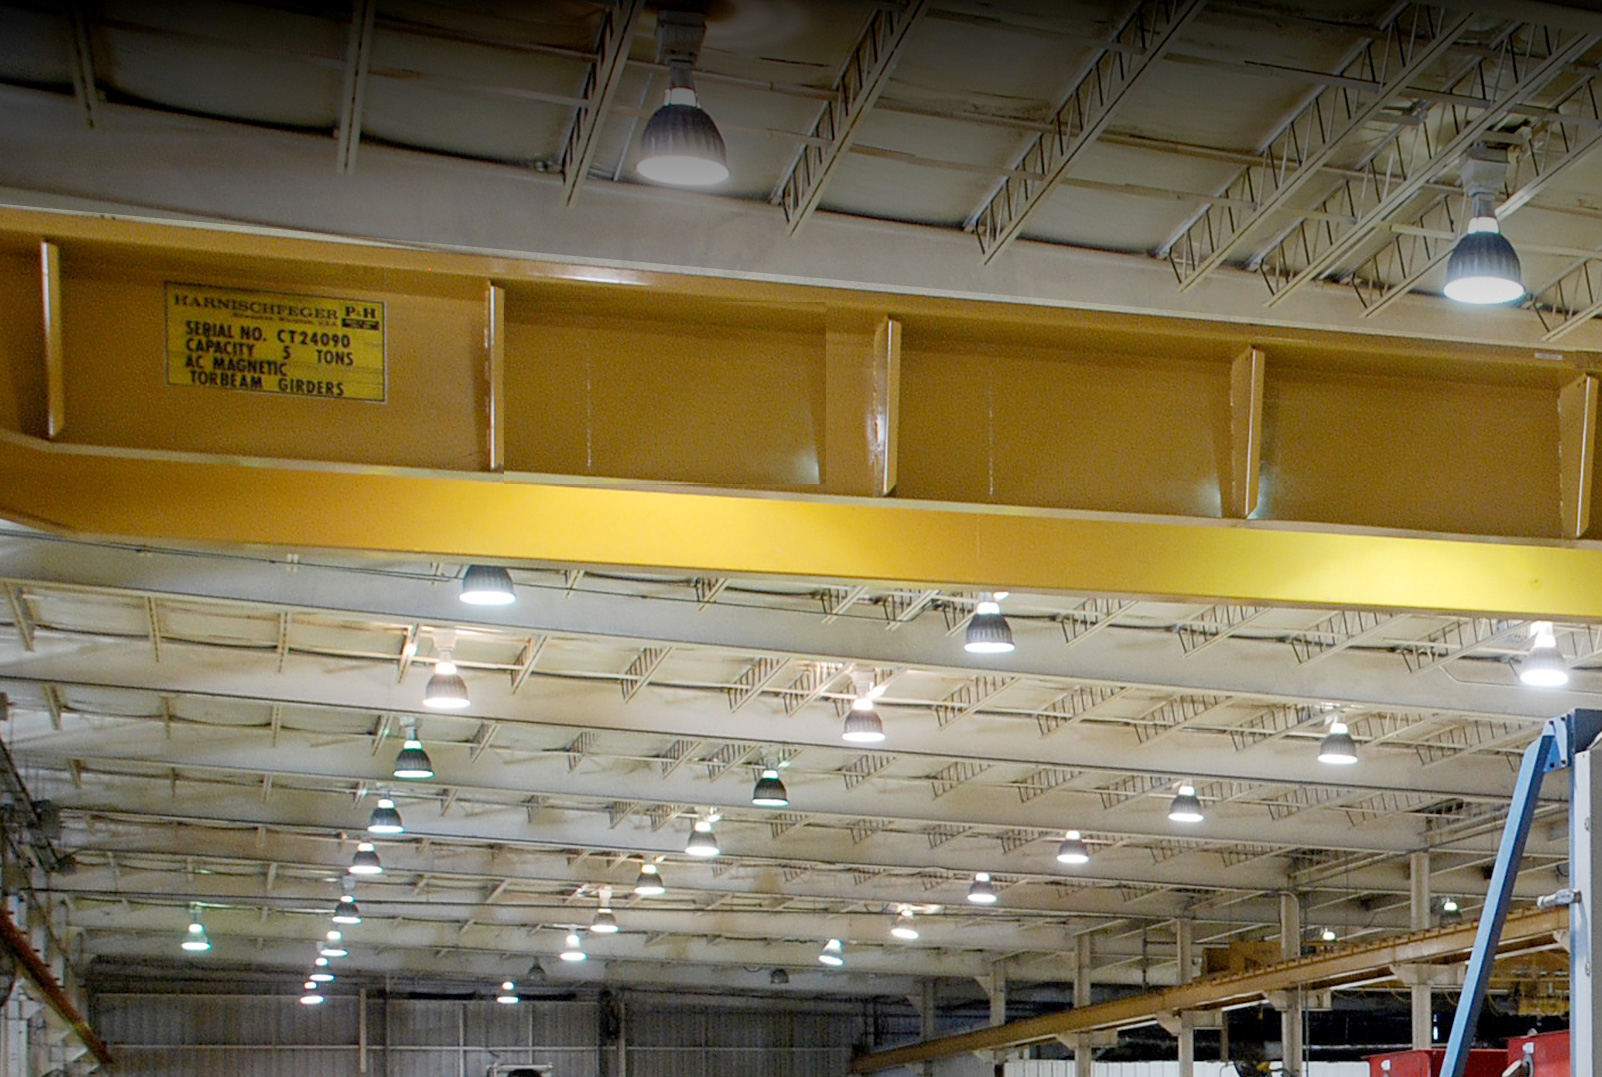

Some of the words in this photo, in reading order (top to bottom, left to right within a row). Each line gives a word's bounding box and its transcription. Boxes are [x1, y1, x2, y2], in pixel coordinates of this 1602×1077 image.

[174, 293, 339, 320] HARNISCHFEGER
[185, 320, 234, 339] SERIAL
[240, 326, 267, 342] NO.
[277, 329, 351, 348] CT24090
[185, 337, 255, 358] CAPACITY
[316, 349, 354, 366] TONS
[185, 355, 204, 370] AC
[213, 357, 288, 377] MAGNETIC
[190, 370, 264, 389] TORBEAM
[278, 378, 345, 397] GIRDERS
